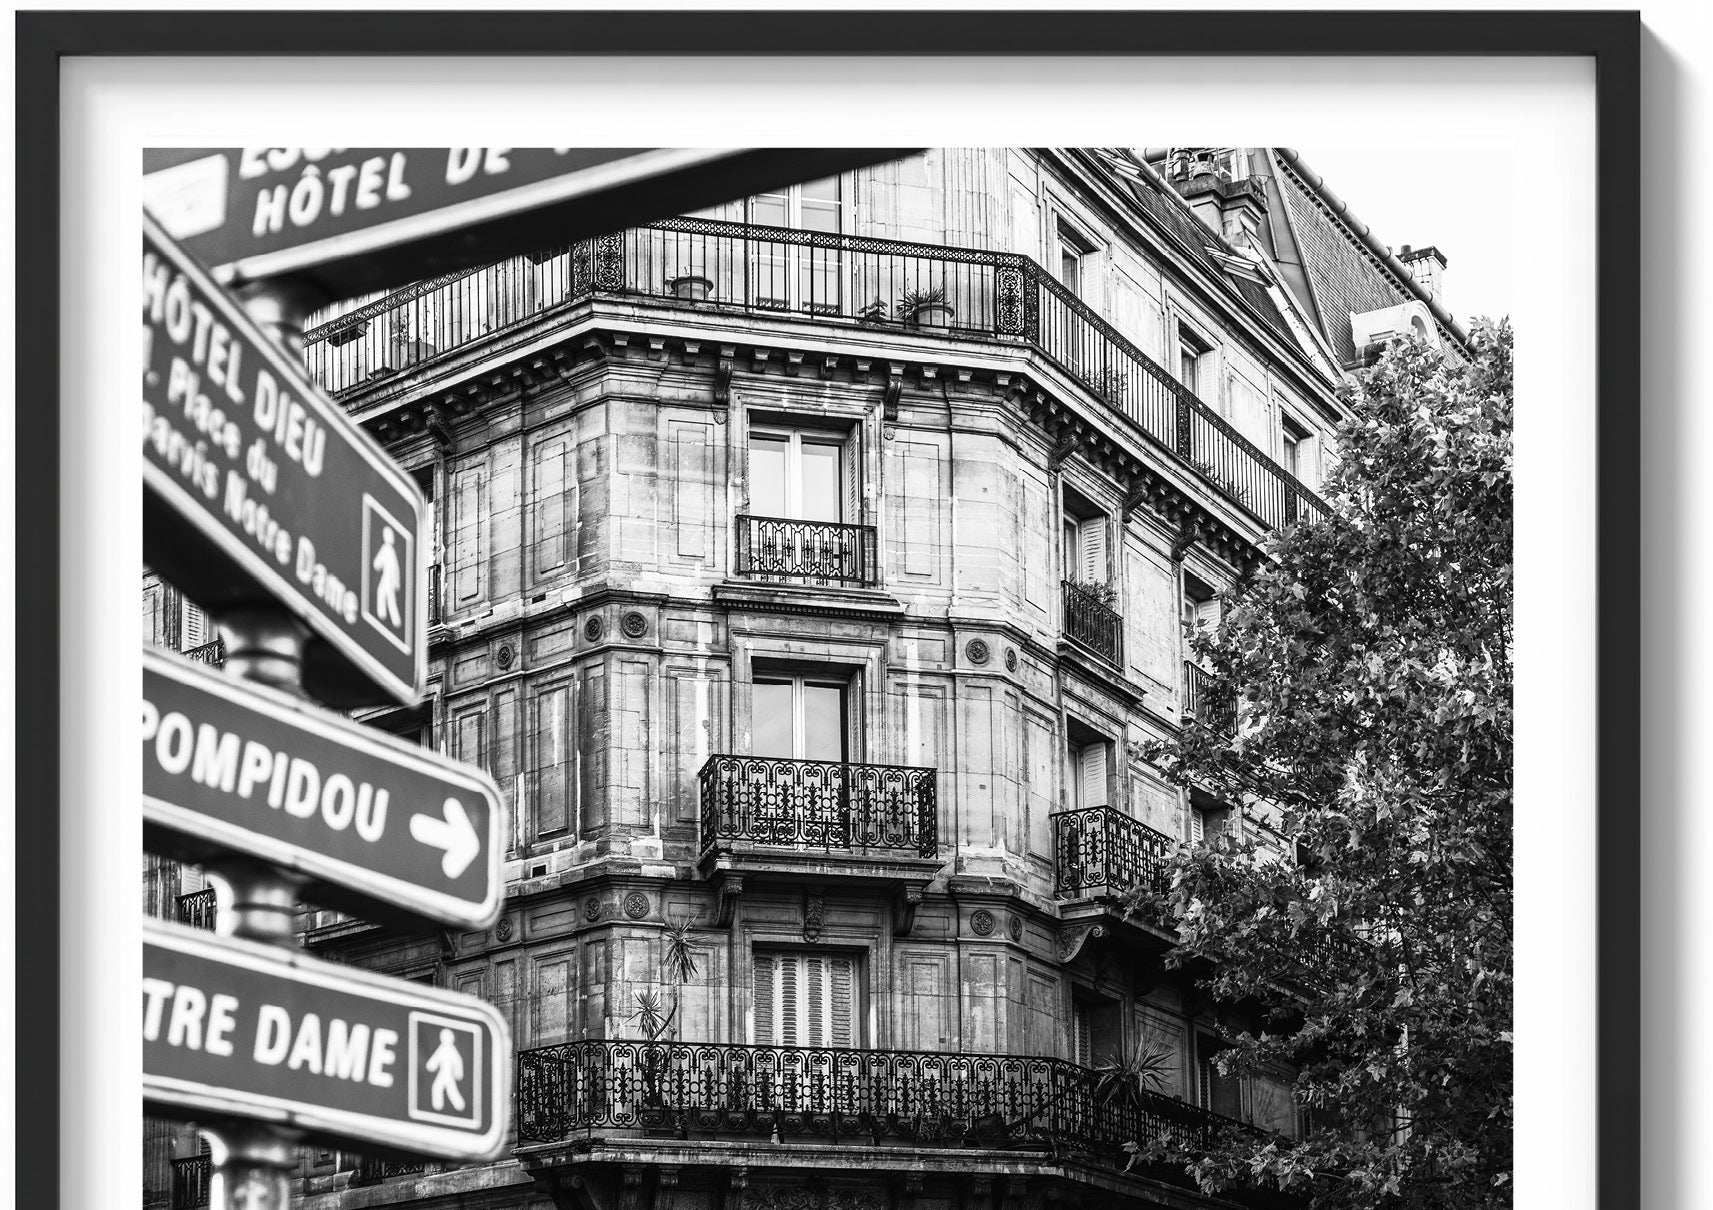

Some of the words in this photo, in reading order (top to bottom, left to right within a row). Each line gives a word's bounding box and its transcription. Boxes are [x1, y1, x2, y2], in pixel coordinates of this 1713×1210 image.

[253, 151, 412, 238] HÔTEL
[143, 252, 246, 405] HÔTEL
[254, 367, 327, 478] DIEU
[246, 437, 279, 496] du
[223, 469, 293, 566] Notre
[295, 535, 359, 625] Dame
[143, 699, 390, 843] POMPIDOU
[252, 1003, 400, 1089] DAME
